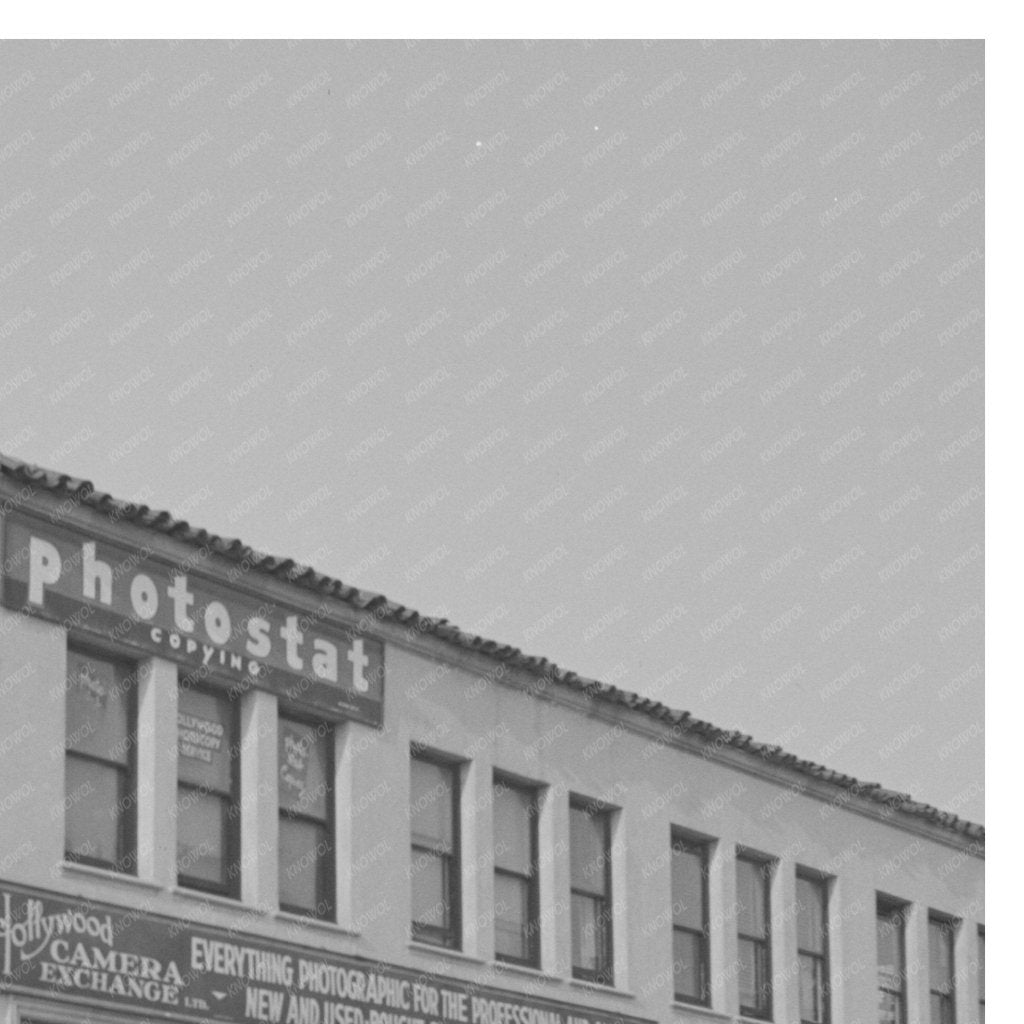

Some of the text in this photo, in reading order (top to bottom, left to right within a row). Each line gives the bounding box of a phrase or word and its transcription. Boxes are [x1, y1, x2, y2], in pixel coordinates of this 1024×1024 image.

[29, 536, 369, 692] photostat
[150, 627, 262, 676] COPYING
[39, 961, 180, 1006] EXCHANGE
[49, 939, 184, 986] CAMERA
[190, 936, 293, 990] EVERYTHING
[298, 958, 411, 1008] PHOTOGRAPHIC
[413, 986, 439, 1017] FOR
[440, 990, 468, 1024] THE
[245, 986, 284, 1022] NEW
